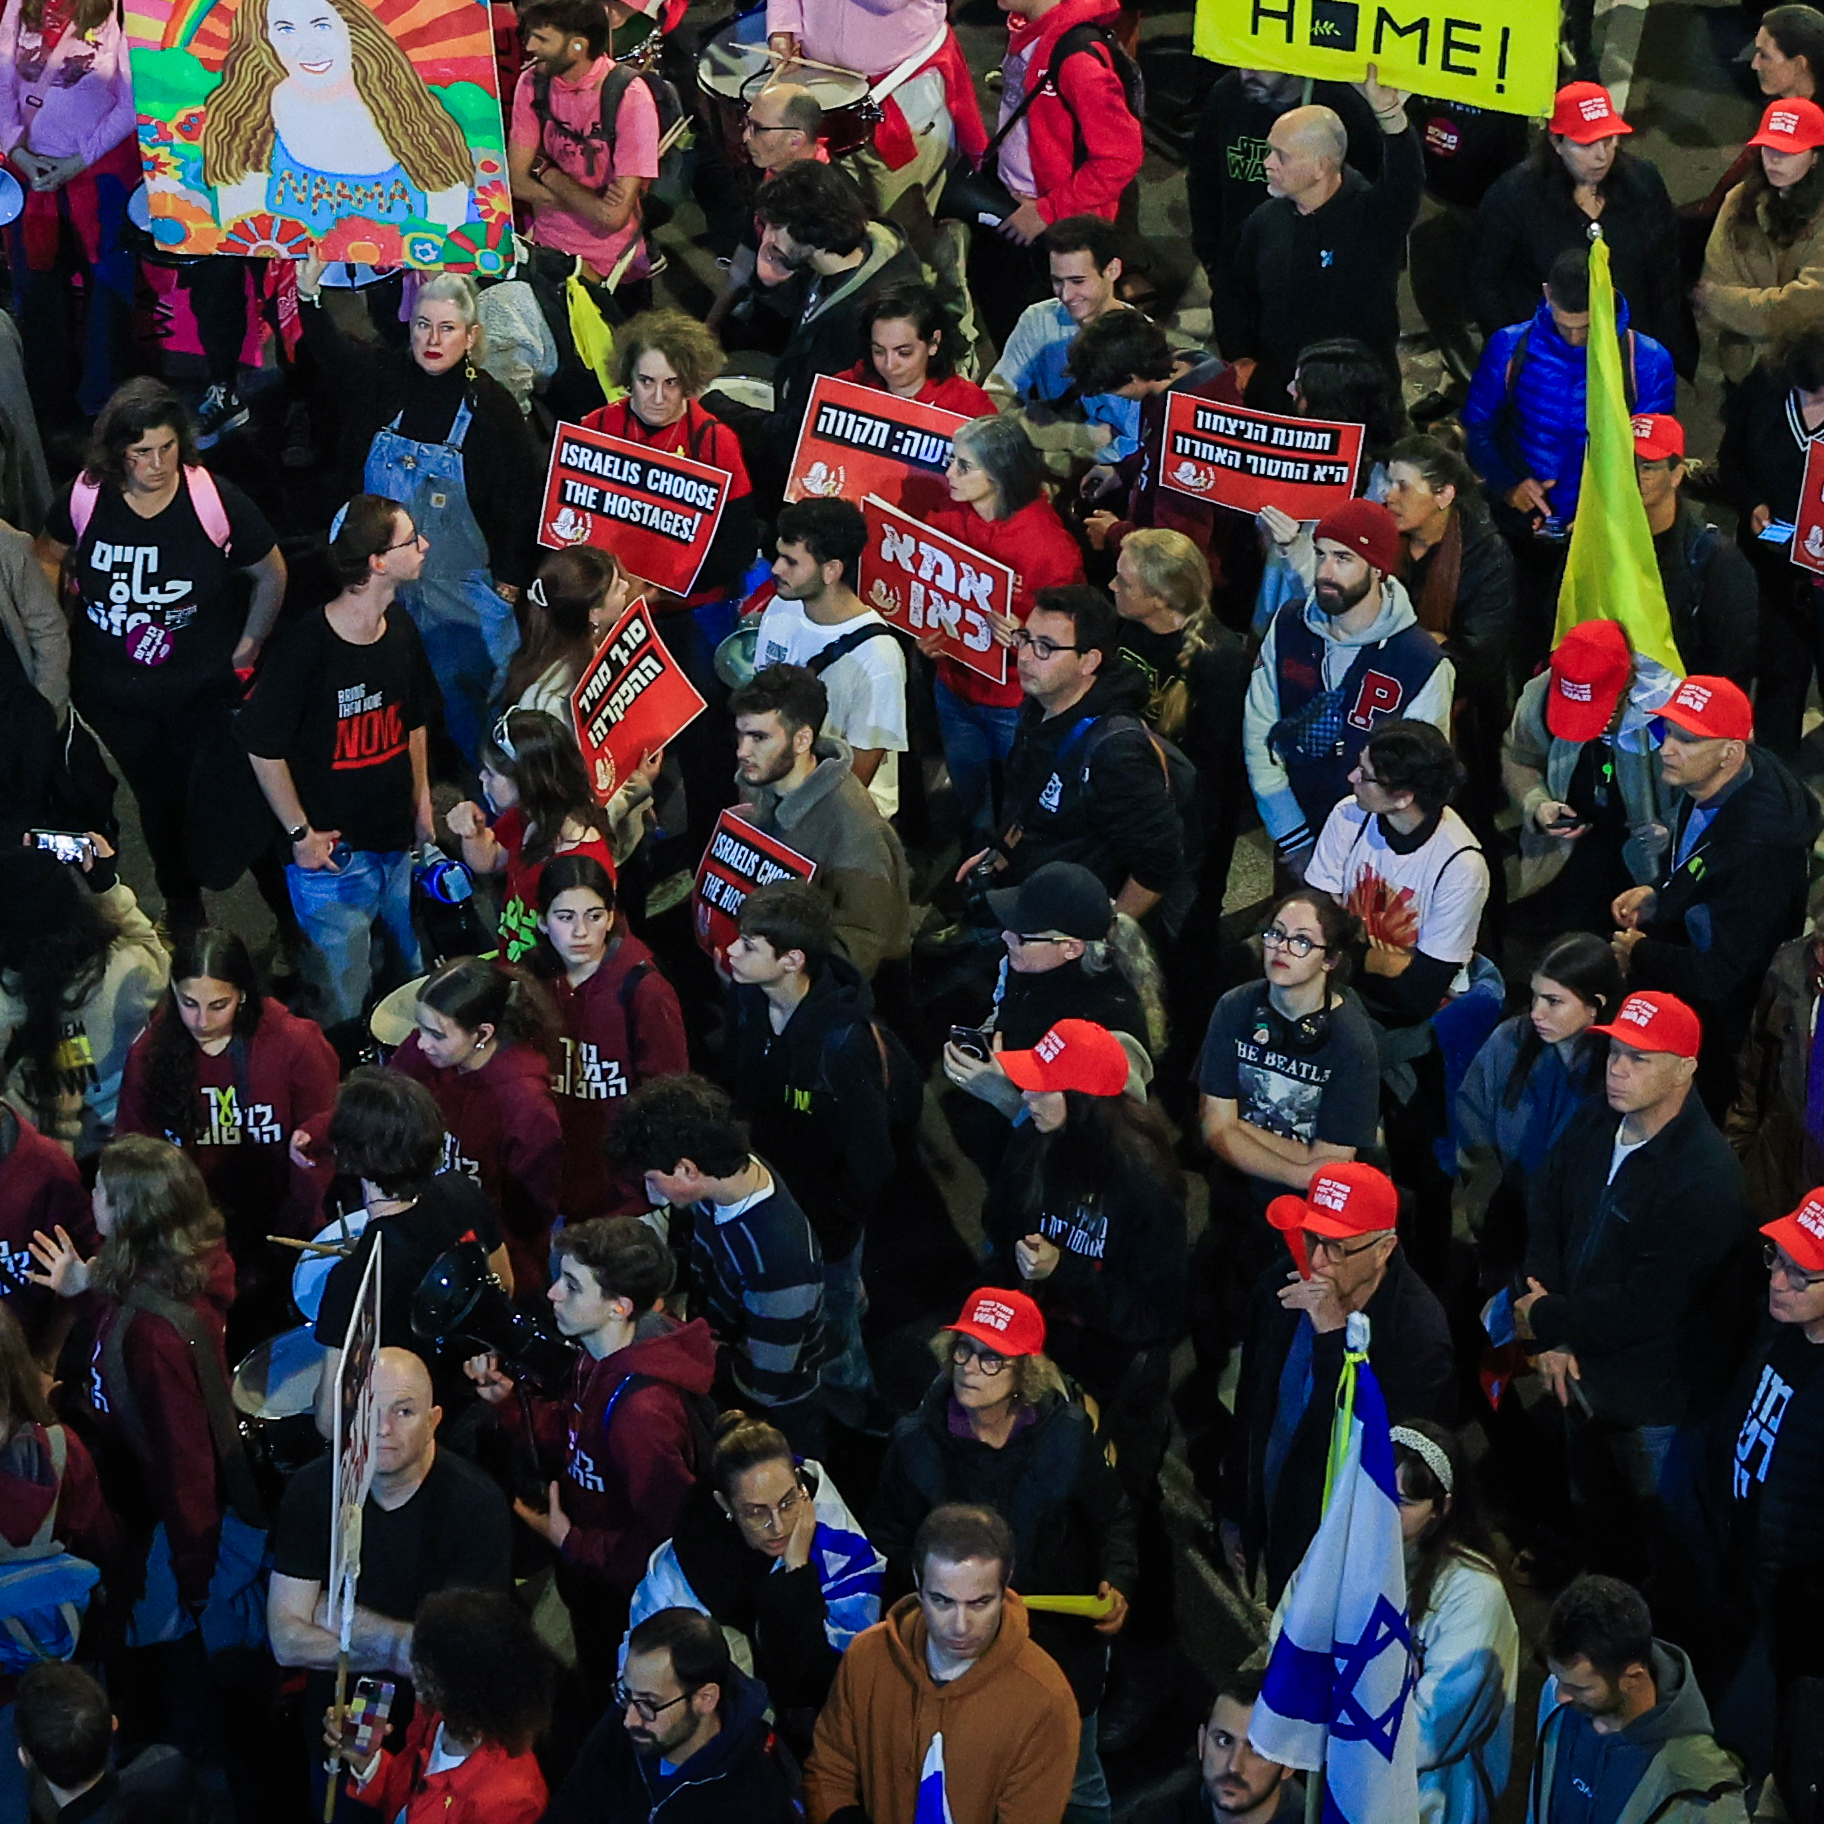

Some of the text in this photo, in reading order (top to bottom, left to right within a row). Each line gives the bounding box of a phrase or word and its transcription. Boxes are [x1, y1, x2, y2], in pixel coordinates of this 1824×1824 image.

[274, 169, 415, 217] NAAMA
[815, 404, 891, 448] תקווה
[1196, 409, 1332, 452] תמונת הניצחון
[559, 441, 721, 512] ISRAELIS CHOOSE
[1175, 435, 1349, 484] היא החטוף האחרון
[563, 480, 704, 544] THE HOSTAGES!
[880, 521, 994, 612] אמא
[908, 580, 993, 653] כאן
[337, 682, 367, 705] BRING
[577, 664, 614, 714] מחיר
[586, 653, 665, 750] ההפקרה!
[1347, 668, 1403, 732] P
[333, 700, 405, 761] NOW
[710, 831, 761, 877] ISRAELIS
[700, 871, 720, 903] THE
